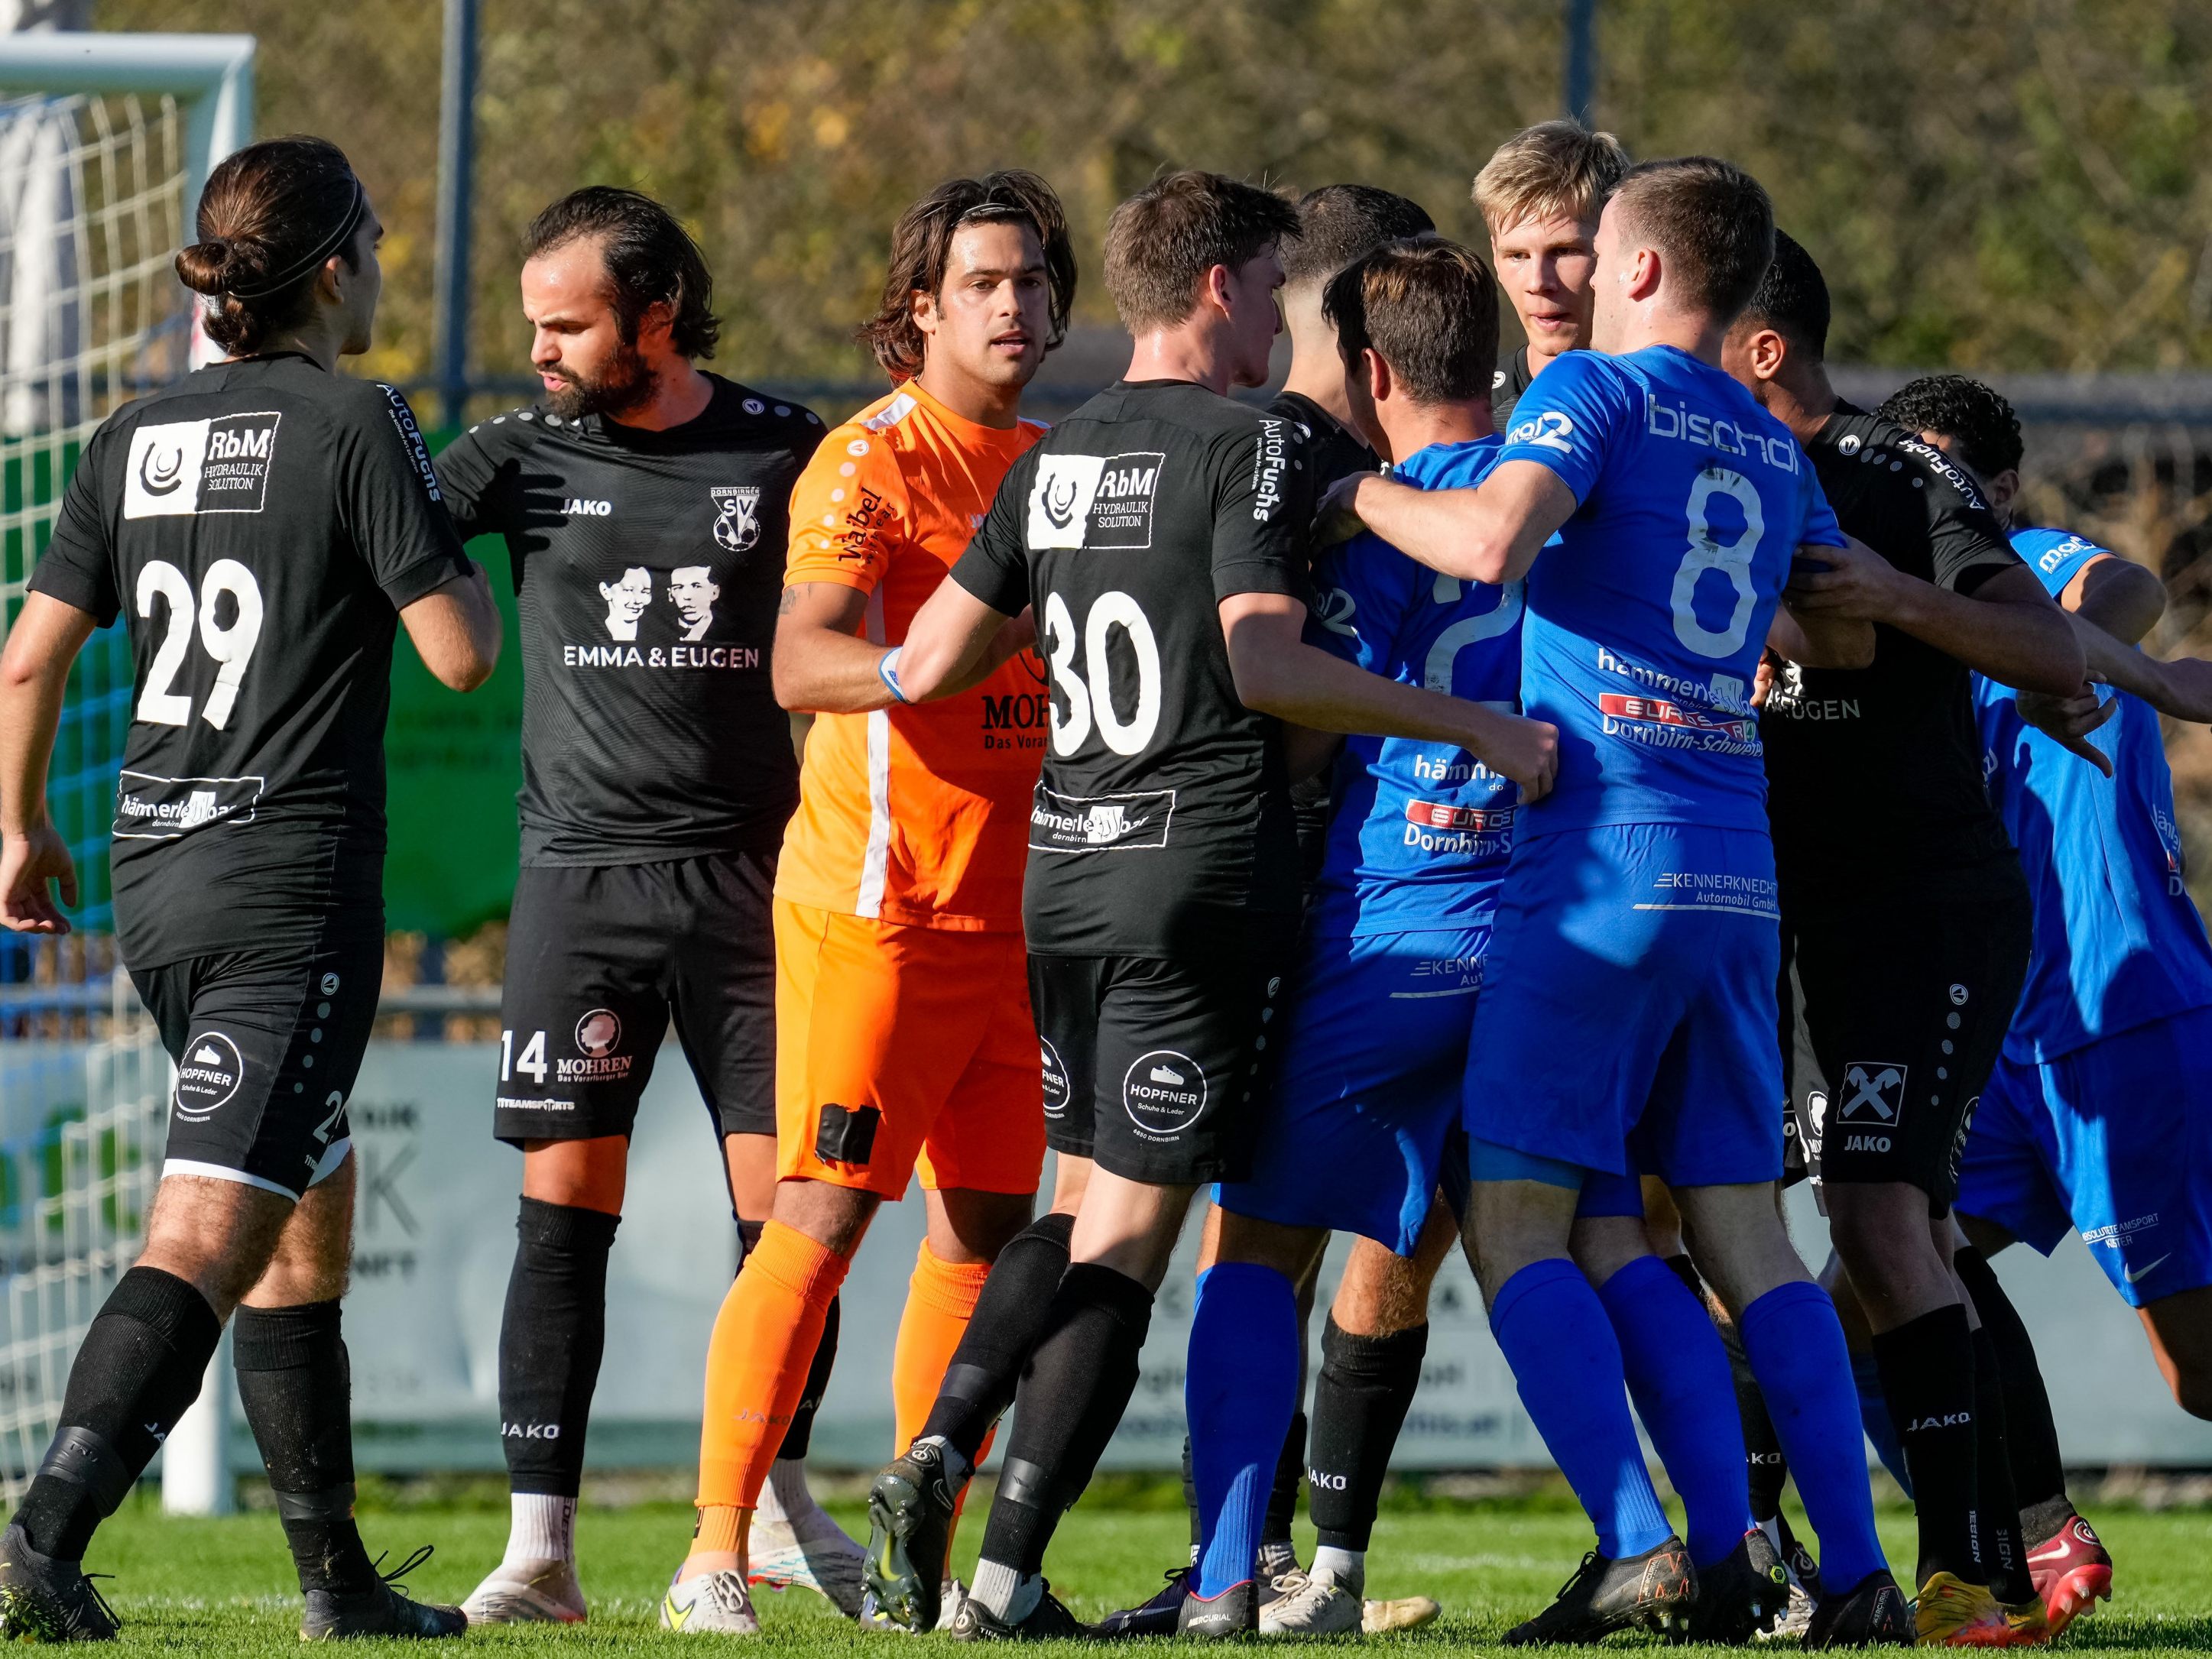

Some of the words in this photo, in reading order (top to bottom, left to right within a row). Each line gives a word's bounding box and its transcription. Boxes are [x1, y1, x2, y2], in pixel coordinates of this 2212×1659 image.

[207, 429, 272, 461] RbM
[203, 462, 264, 478] HYDRAULIK
[1253, 420, 1286, 522] AutoFuchs
[1096, 468, 1156, 497] RbM
[559, 498, 612, 516] JAKO
[723, 498, 754, 517] SV
[1092, 501, 1149, 514] HYDRAULIK
[838, 486, 882, 562] Waibel
[1098, 516, 1142, 528] SOLUTION
[1670, 467, 1765, 658] 8
[136, 559, 264, 730] 29
[563, 645, 644, 667] EMMA
[648, 646, 667, 667] &
[671, 647, 759, 668] EUGEN
[1045, 591, 1161, 756] 30
[981, 693, 1050, 730] MOH
[984, 734, 1010, 750] Das
[1017, 734, 1048, 749] Vorar
[152, 819, 180, 828] dornbirn
[1052, 831, 1087, 843] dornbirn
[501, 1030, 548, 1084] 14
[556, 1056, 633, 1074] MOHREN
[180, 1068, 232, 1087] HOPFNER
[557, 1074, 572, 1082] Das
[1042, 1069, 1064, 1088] FNER
[1130, 1084, 1198, 1105] HOPFNER
[1137, 1103, 1160, 1112] Schuhe
[1166, 1107, 1185, 1116] Leder
[1844, 1136, 1892, 1152] JAKO
[501, 1421, 560, 1440] JAKO
[1906, 1412, 1971, 1431] JAKO
[1187, 1613, 1231, 1628] MERCURIAL
